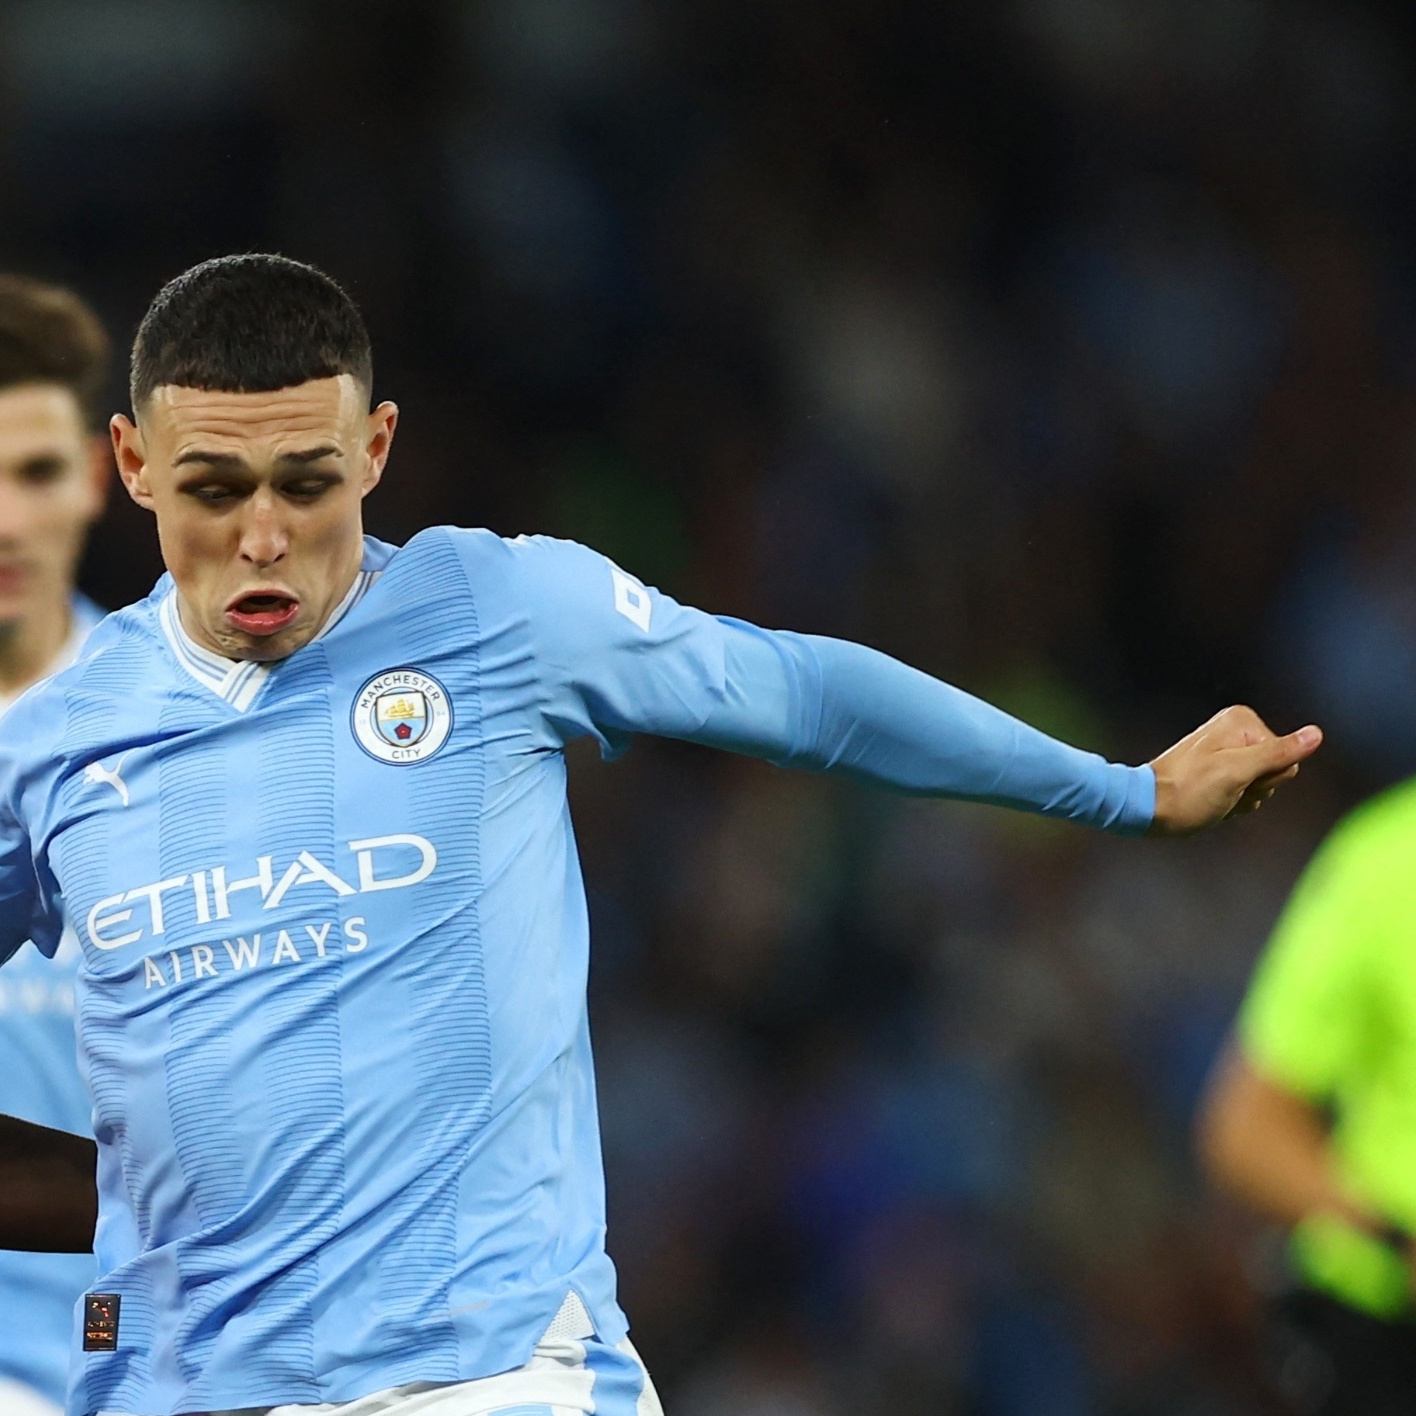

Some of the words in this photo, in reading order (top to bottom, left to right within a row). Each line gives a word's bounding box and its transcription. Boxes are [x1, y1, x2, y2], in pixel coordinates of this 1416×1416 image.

[361, 674, 441, 709] MANCHESTER
[391, 748, 421, 760] CITY
[87, 833, 438, 951] ETIHAD
[144, 916, 370, 990] AIRWAYS
